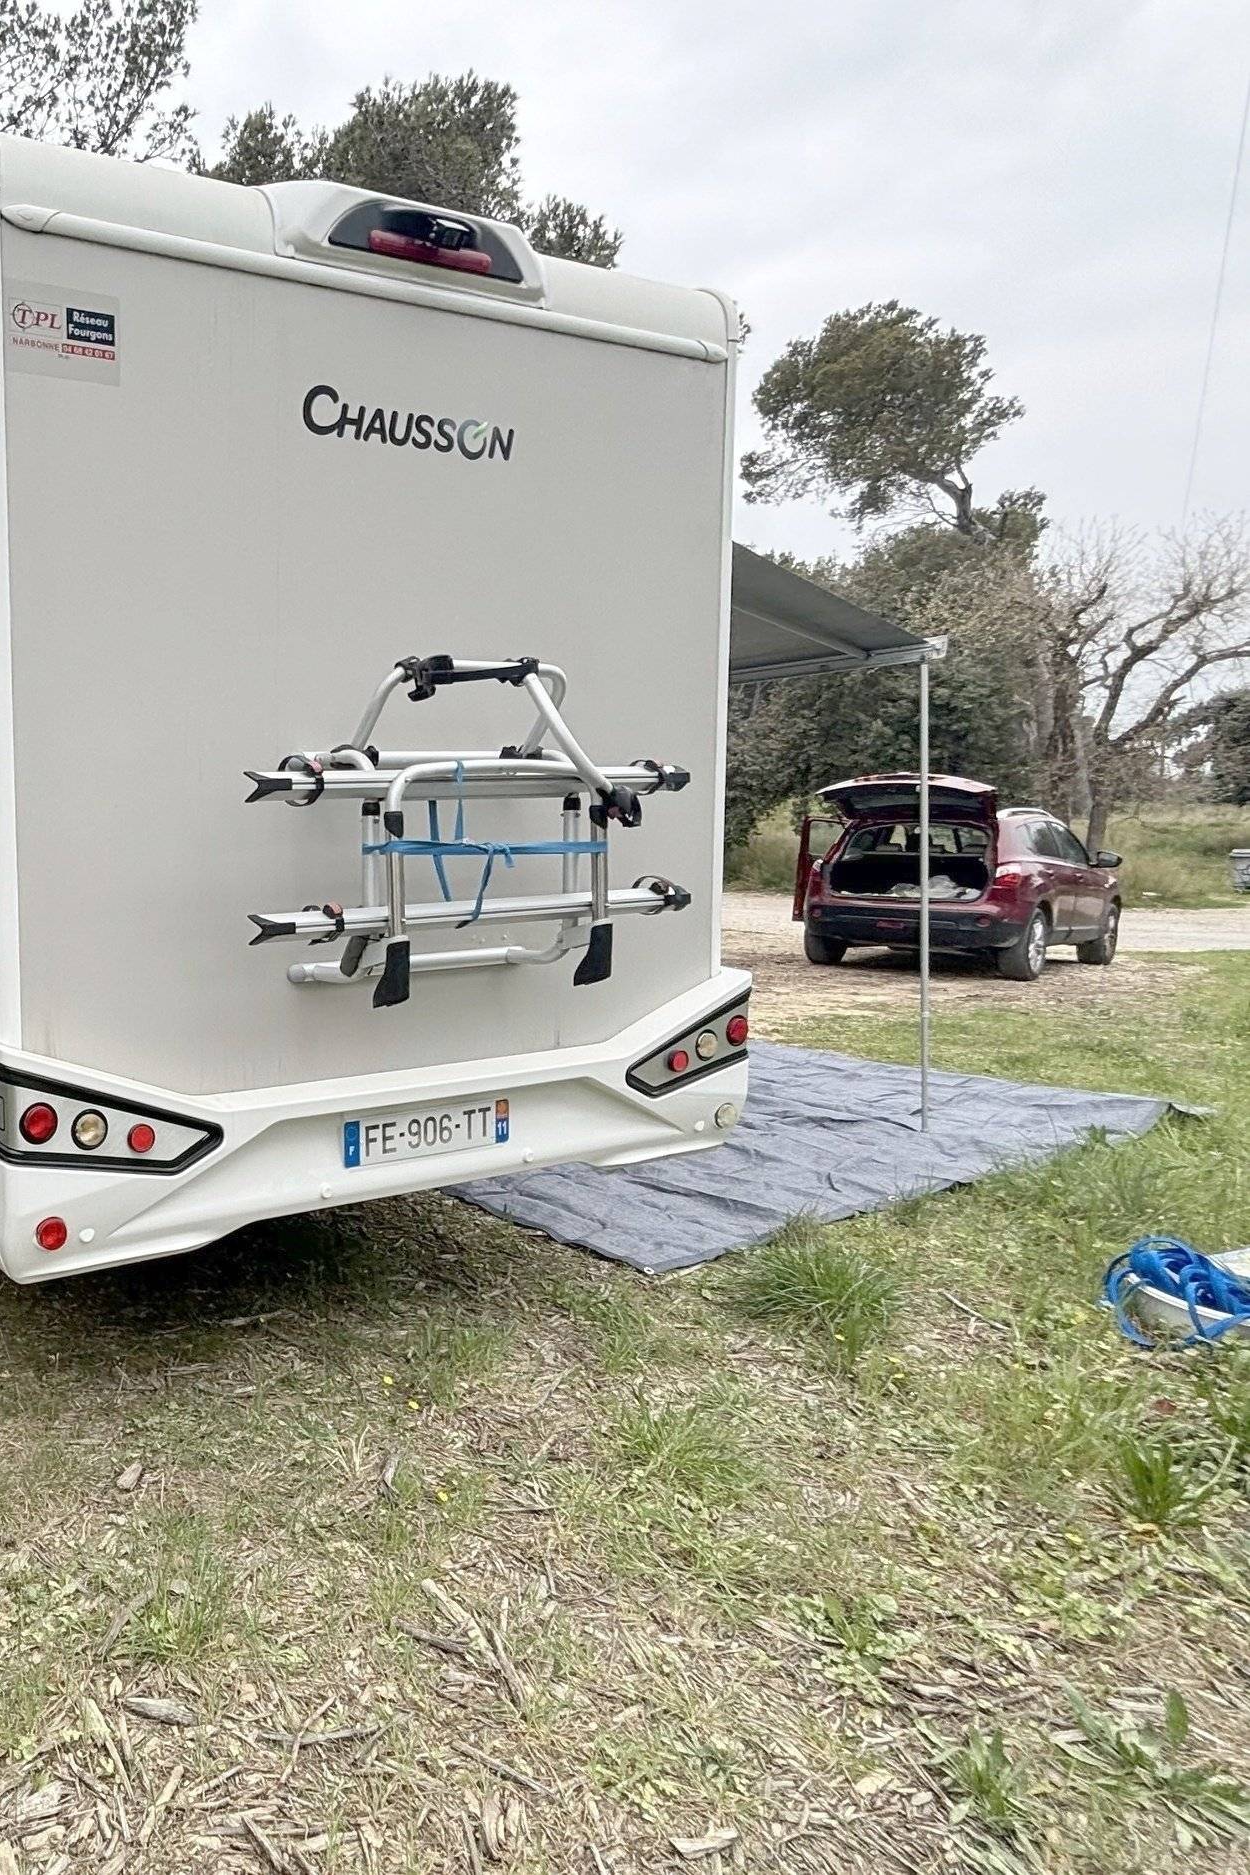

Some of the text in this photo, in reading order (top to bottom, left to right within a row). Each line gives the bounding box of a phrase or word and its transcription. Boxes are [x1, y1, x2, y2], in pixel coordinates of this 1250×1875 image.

[13, 304, 61, 329] TPL
[73, 311, 108, 327] Réseau
[68, 323, 113, 341] Fourgons
[12, 337, 60, 351] NARBONNE
[303, 384, 514, 461] CHAUSSON
[349, 1107, 507, 1157] F FE-906-TT 11
